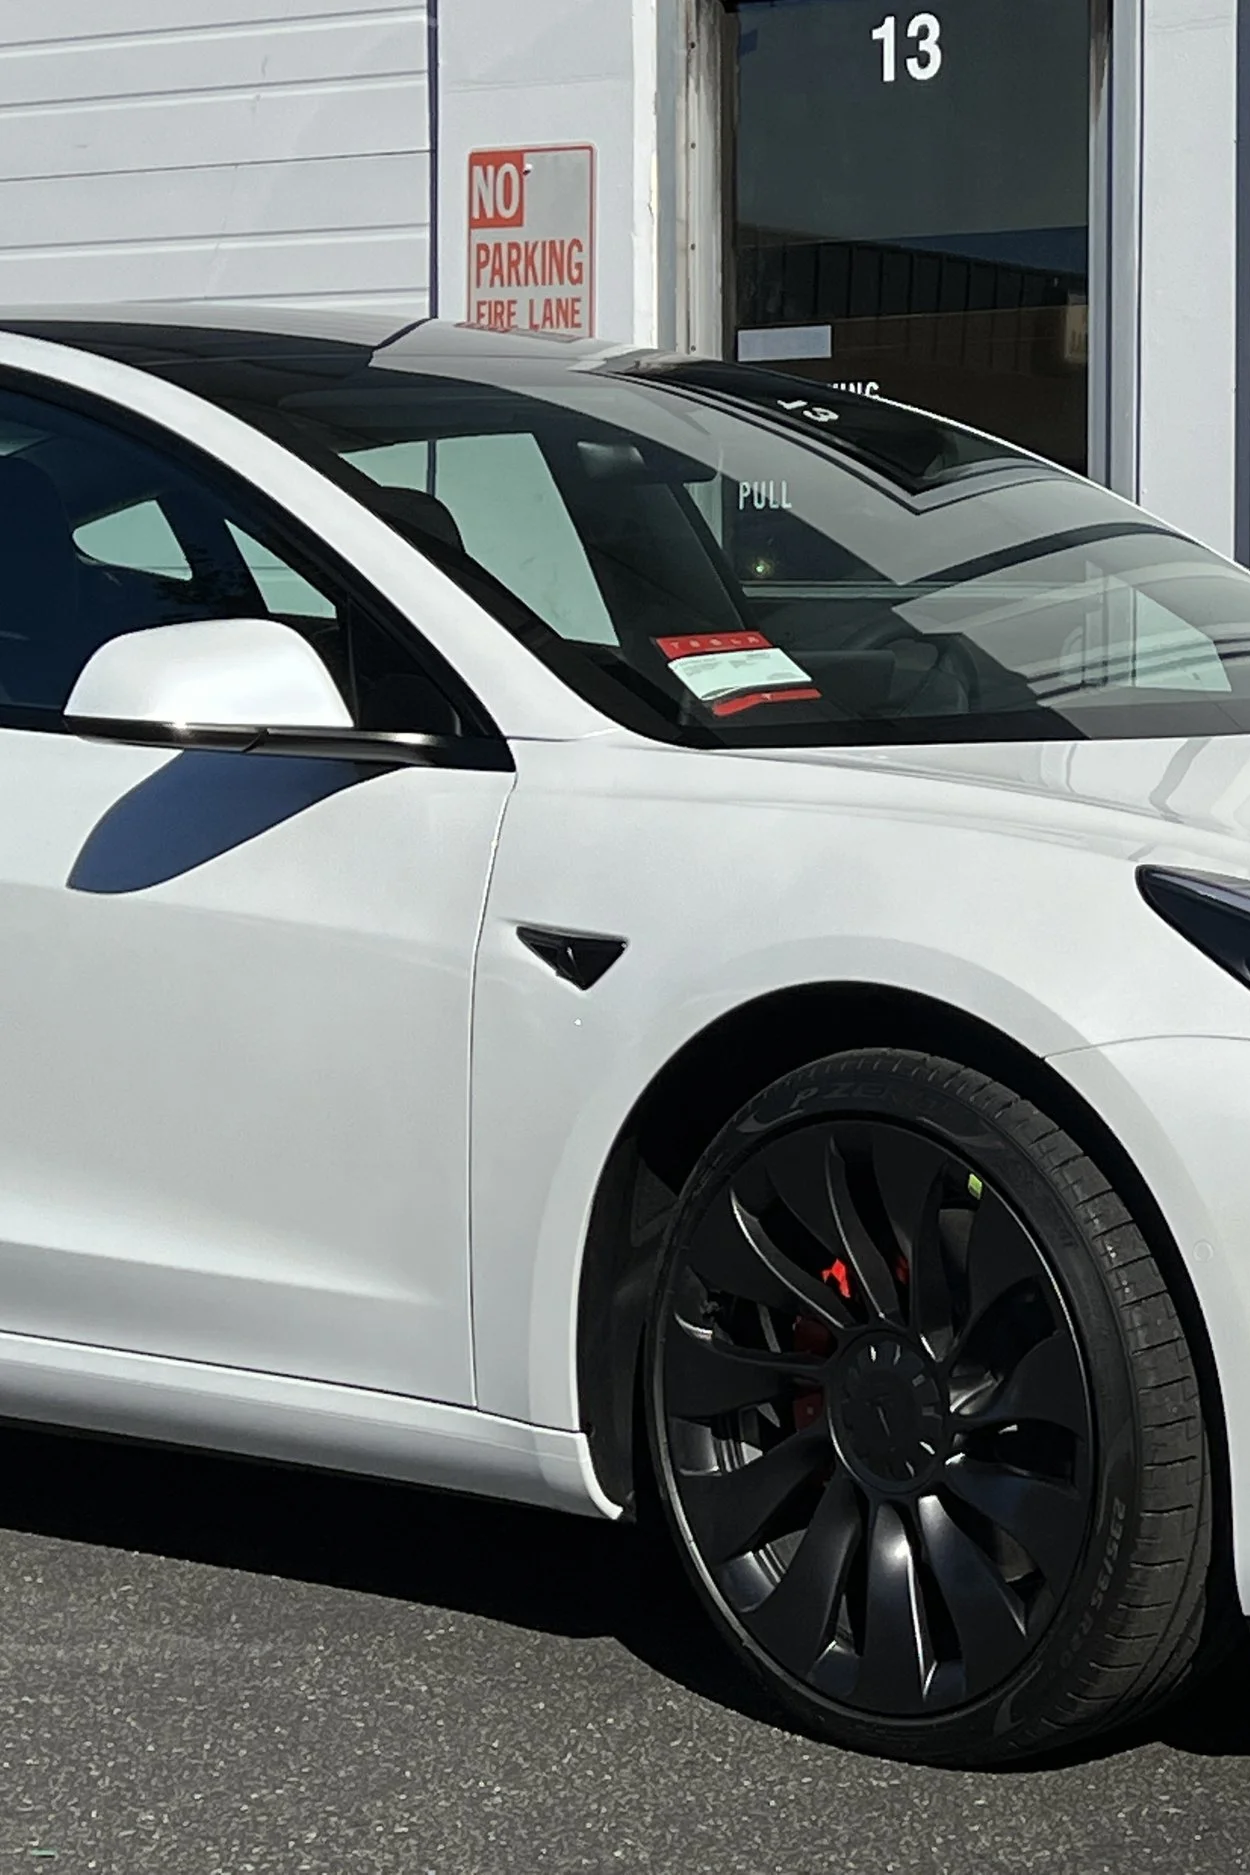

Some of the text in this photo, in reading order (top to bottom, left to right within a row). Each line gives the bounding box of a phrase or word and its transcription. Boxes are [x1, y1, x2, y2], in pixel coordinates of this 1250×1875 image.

[871, 12, 942, 82] 13
[472, 163, 519, 220] NO
[475, 238, 583, 288] PARKING
[476, 297, 582, 330] FIRE LANE
[739, 480, 793, 511] PULL
